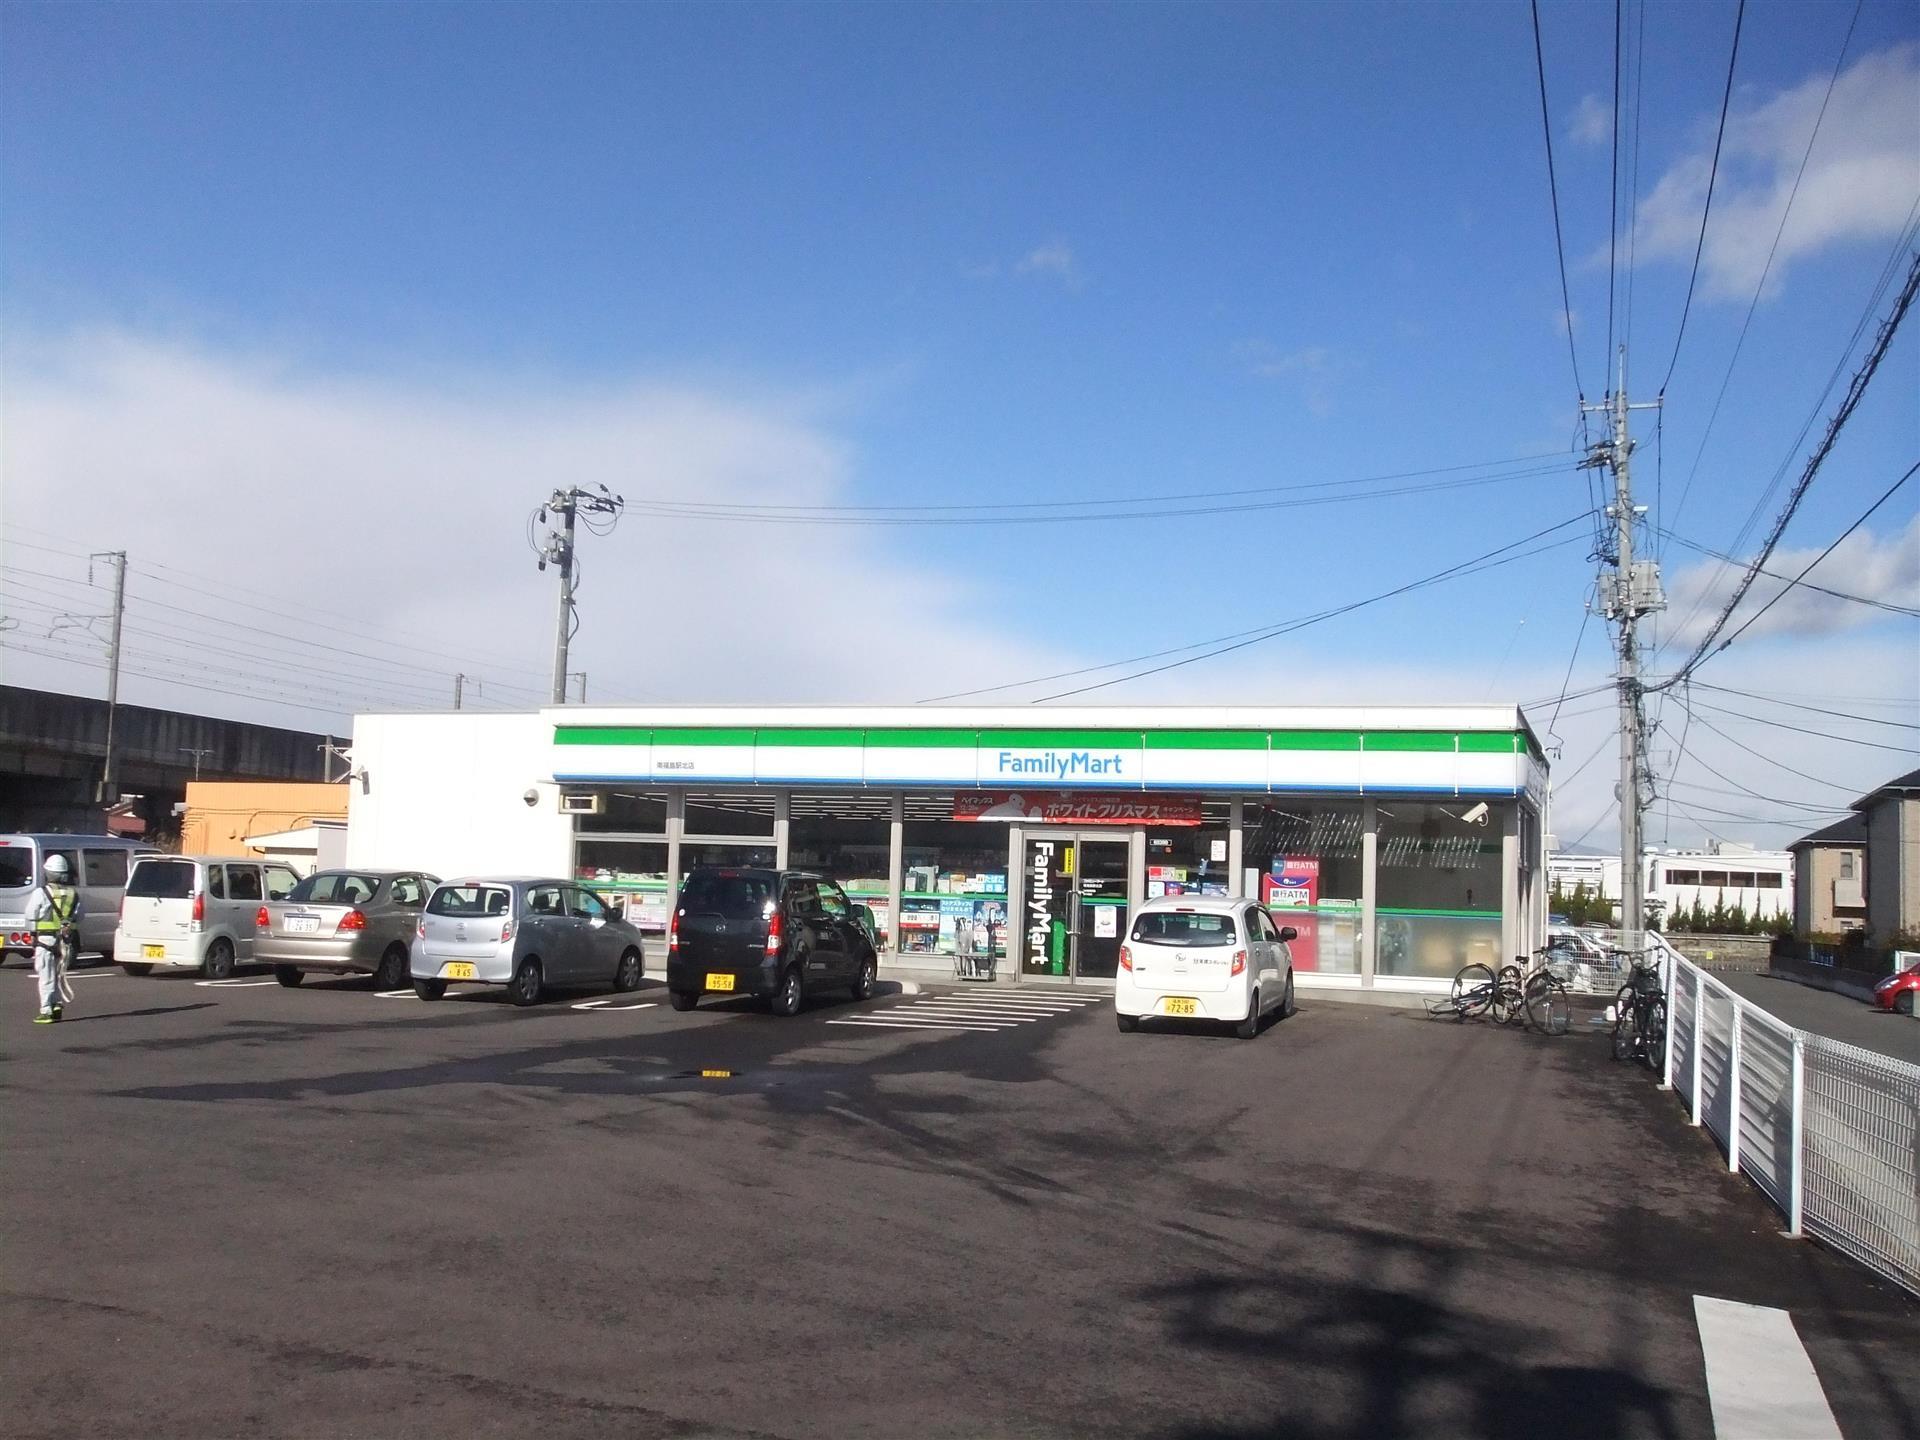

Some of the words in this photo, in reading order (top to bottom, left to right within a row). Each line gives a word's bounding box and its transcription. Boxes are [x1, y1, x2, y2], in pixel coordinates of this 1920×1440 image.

[999, 752, 1122, 778] FamilyMart
[1046, 803, 1160, 818] ホワイトクリスマス
[1028, 842, 1055, 965] FamilyMart
